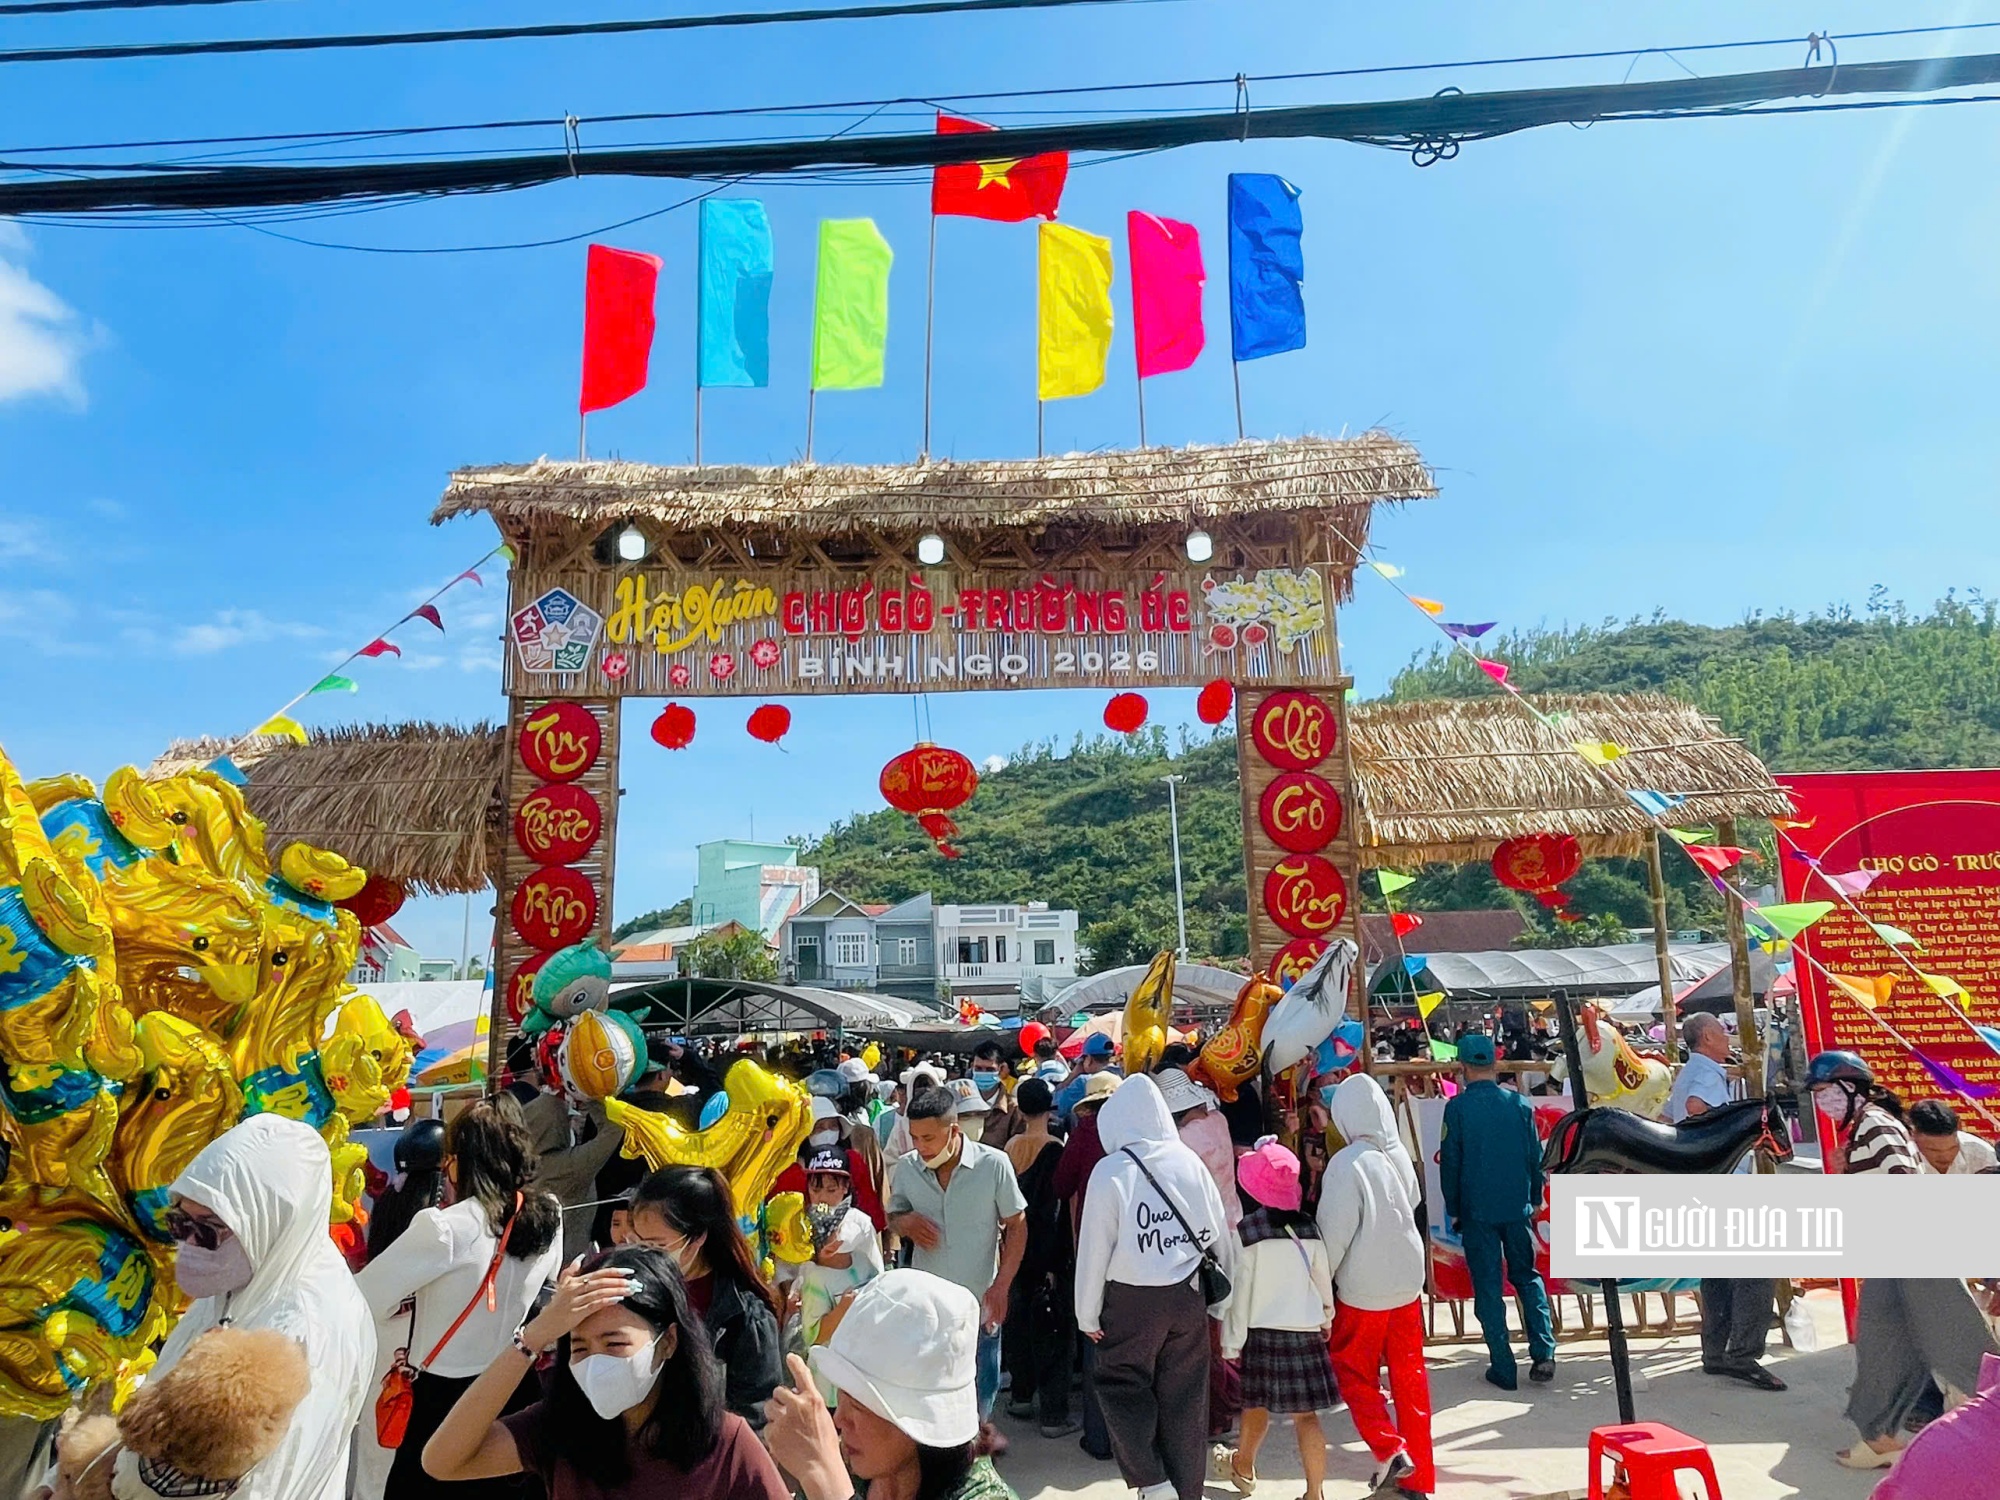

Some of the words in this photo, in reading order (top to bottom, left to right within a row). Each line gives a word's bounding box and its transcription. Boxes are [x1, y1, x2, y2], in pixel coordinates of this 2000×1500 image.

[672, 576, 778, 650] Xuân
[783, 580, 874, 644] CHỢ
[880, 573, 934, 634] GÒ
[961, 573, 1126, 635] TRƯỜNG
[1140, 571, 1192, 634] ÚC
[798, 648, 904, 680] BÍNH
[930, 653, 1029, 684] NGỌ
[1053, 650, 1159, 672] 2026
[1262, 699, 1325, 761] Chợ
[1272, 780, 1327, 832] Gò
[1908, 852, 1939, 872] GÒ
